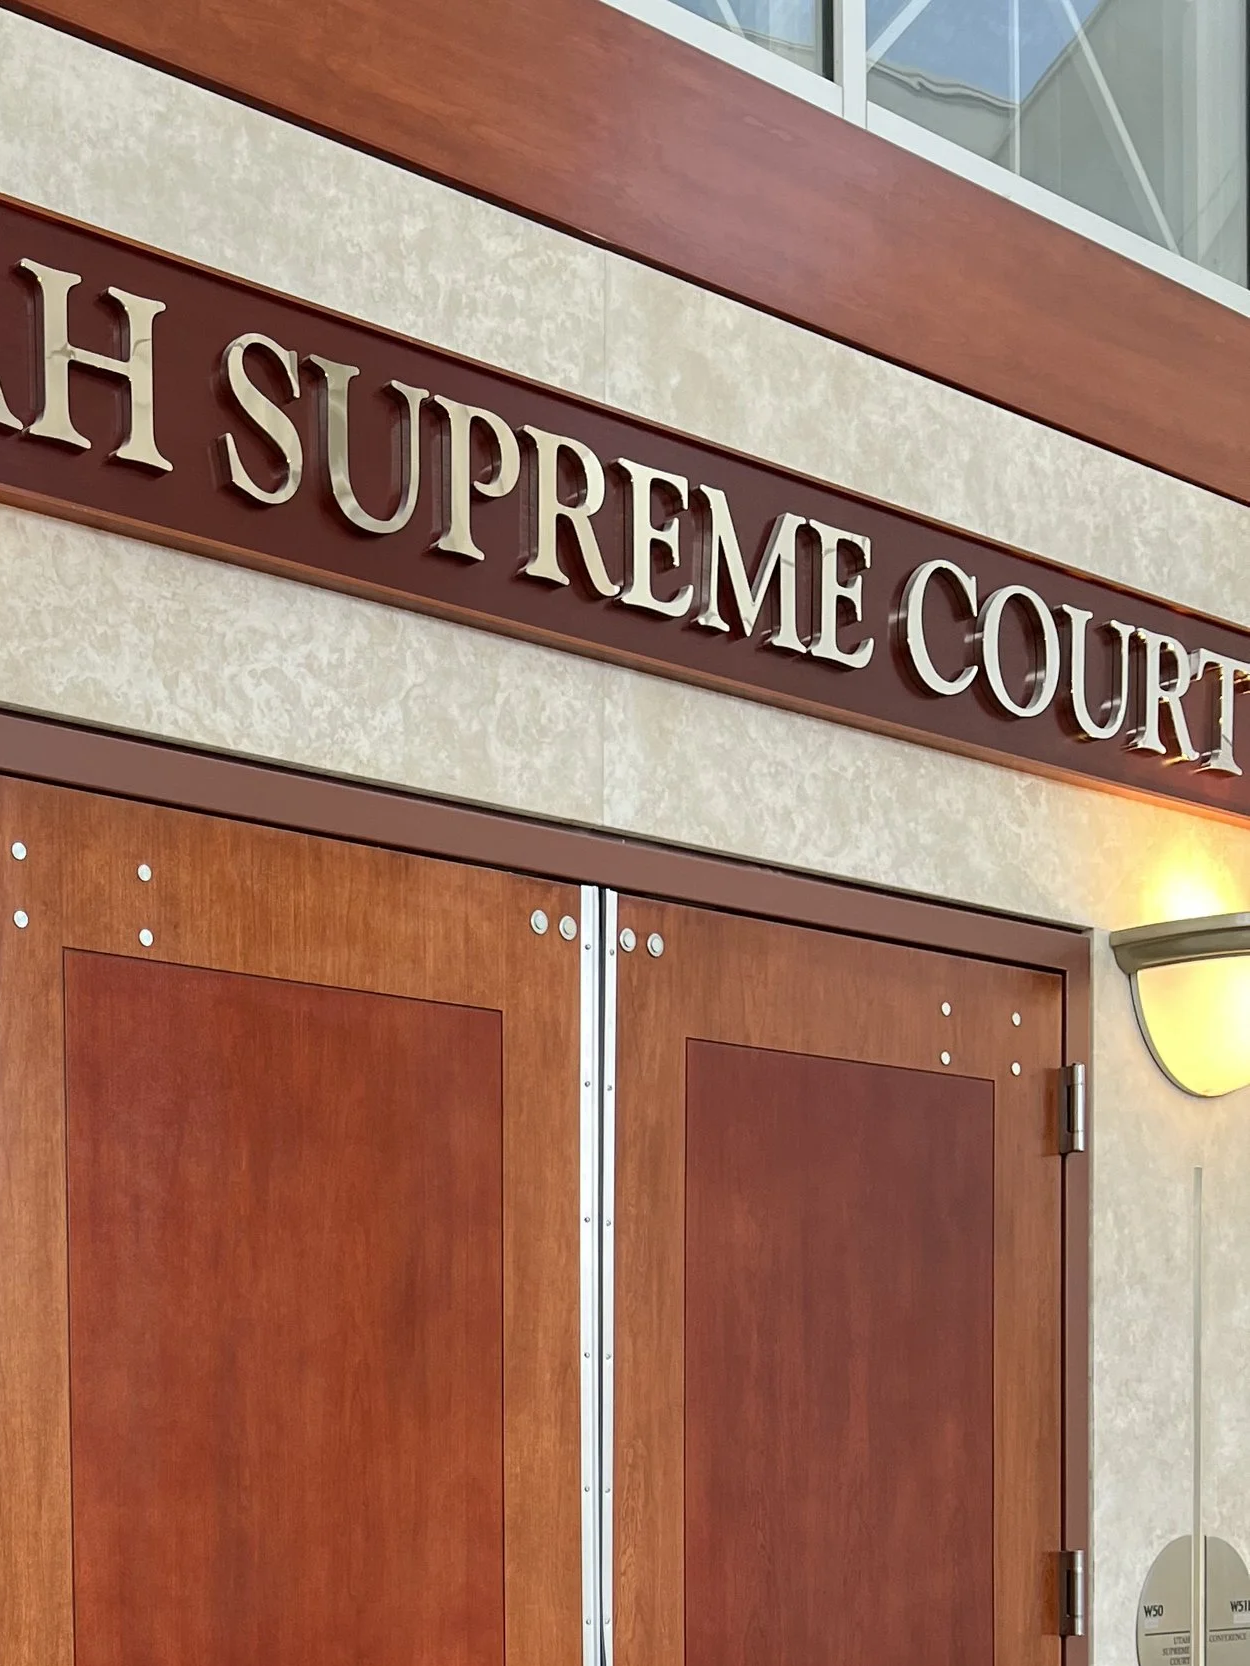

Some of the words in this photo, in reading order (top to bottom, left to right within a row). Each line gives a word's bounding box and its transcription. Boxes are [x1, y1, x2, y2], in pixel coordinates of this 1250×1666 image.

[213, 330, 872, 670] SUPREME
[895, 558, 1250, 777] COURT
[1144, 1605, 1164, 1617] W50
[1209, 1633, 1247, 1643] CONFERENCE
